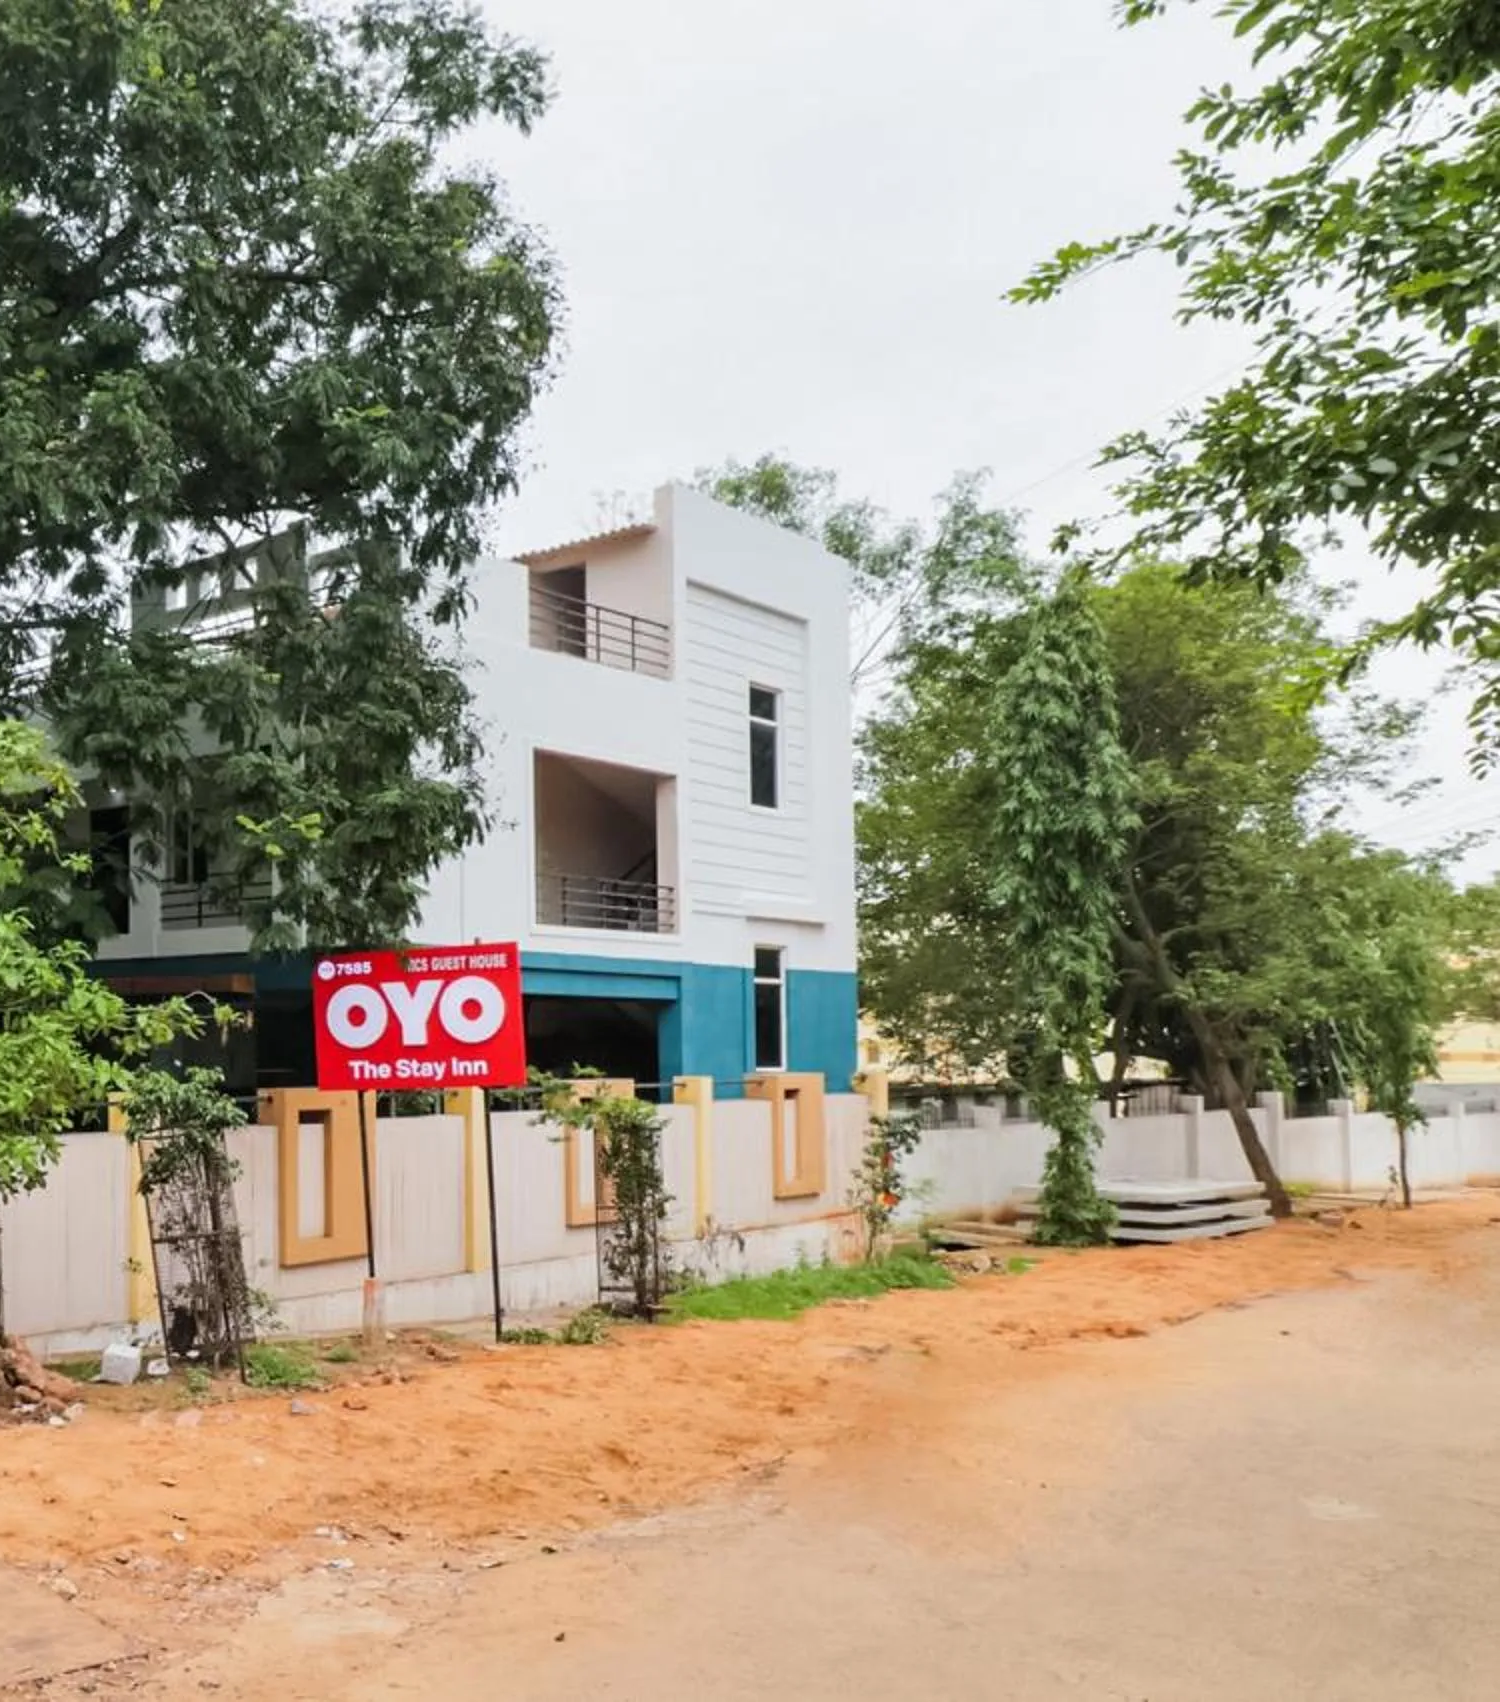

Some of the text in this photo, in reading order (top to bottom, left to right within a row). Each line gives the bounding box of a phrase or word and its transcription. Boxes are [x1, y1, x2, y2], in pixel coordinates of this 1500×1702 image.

[431, 955, 467, 972] GUEST
[469, 953, 508, 970] HOUSE
[327, 975, 505, 1049] OYO
[349, 1057, 488, 1081] The Stay Inn
